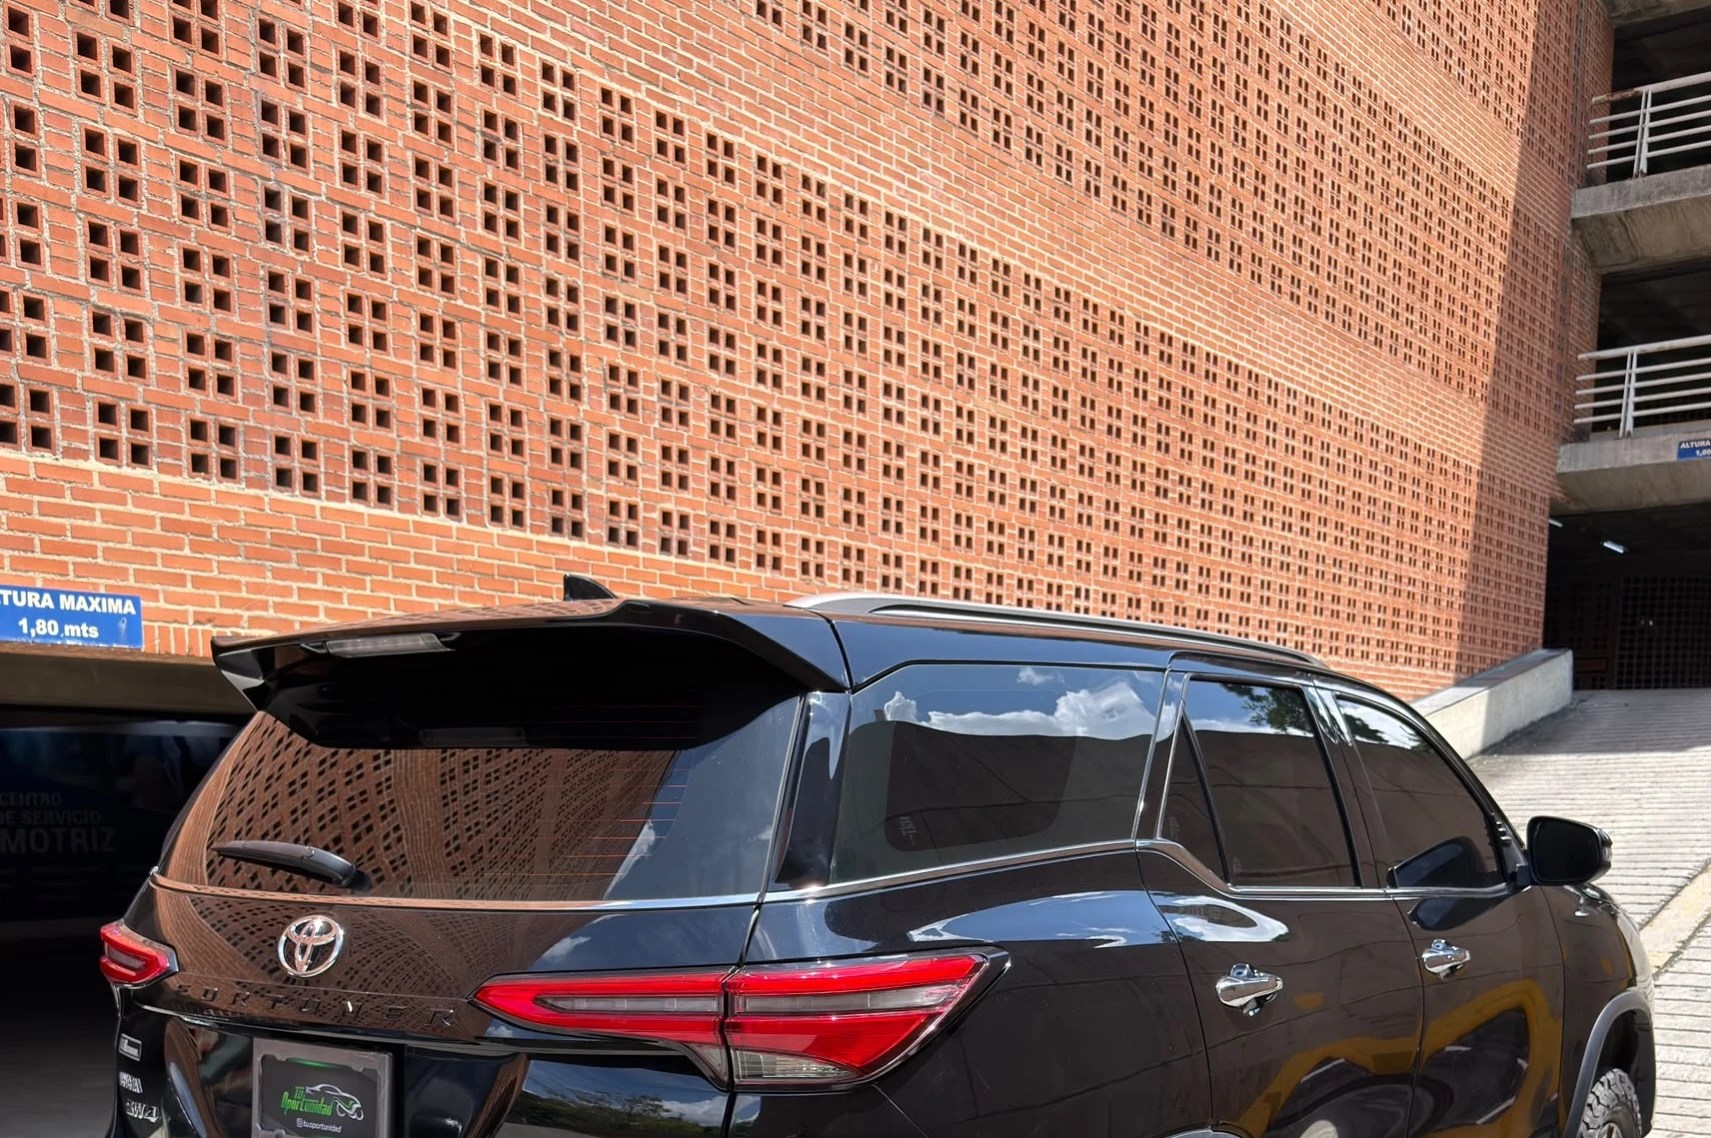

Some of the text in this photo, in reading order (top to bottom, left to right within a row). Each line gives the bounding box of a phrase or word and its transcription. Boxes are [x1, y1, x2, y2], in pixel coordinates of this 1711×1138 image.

[1680, 440, 1711, 449] ALTURA
[0, 589, 136, 615] TURA MAXIMA
[18, 617, 99, 638] 1,80 mts
[0, 826, 116, 854] MOTRIZ
